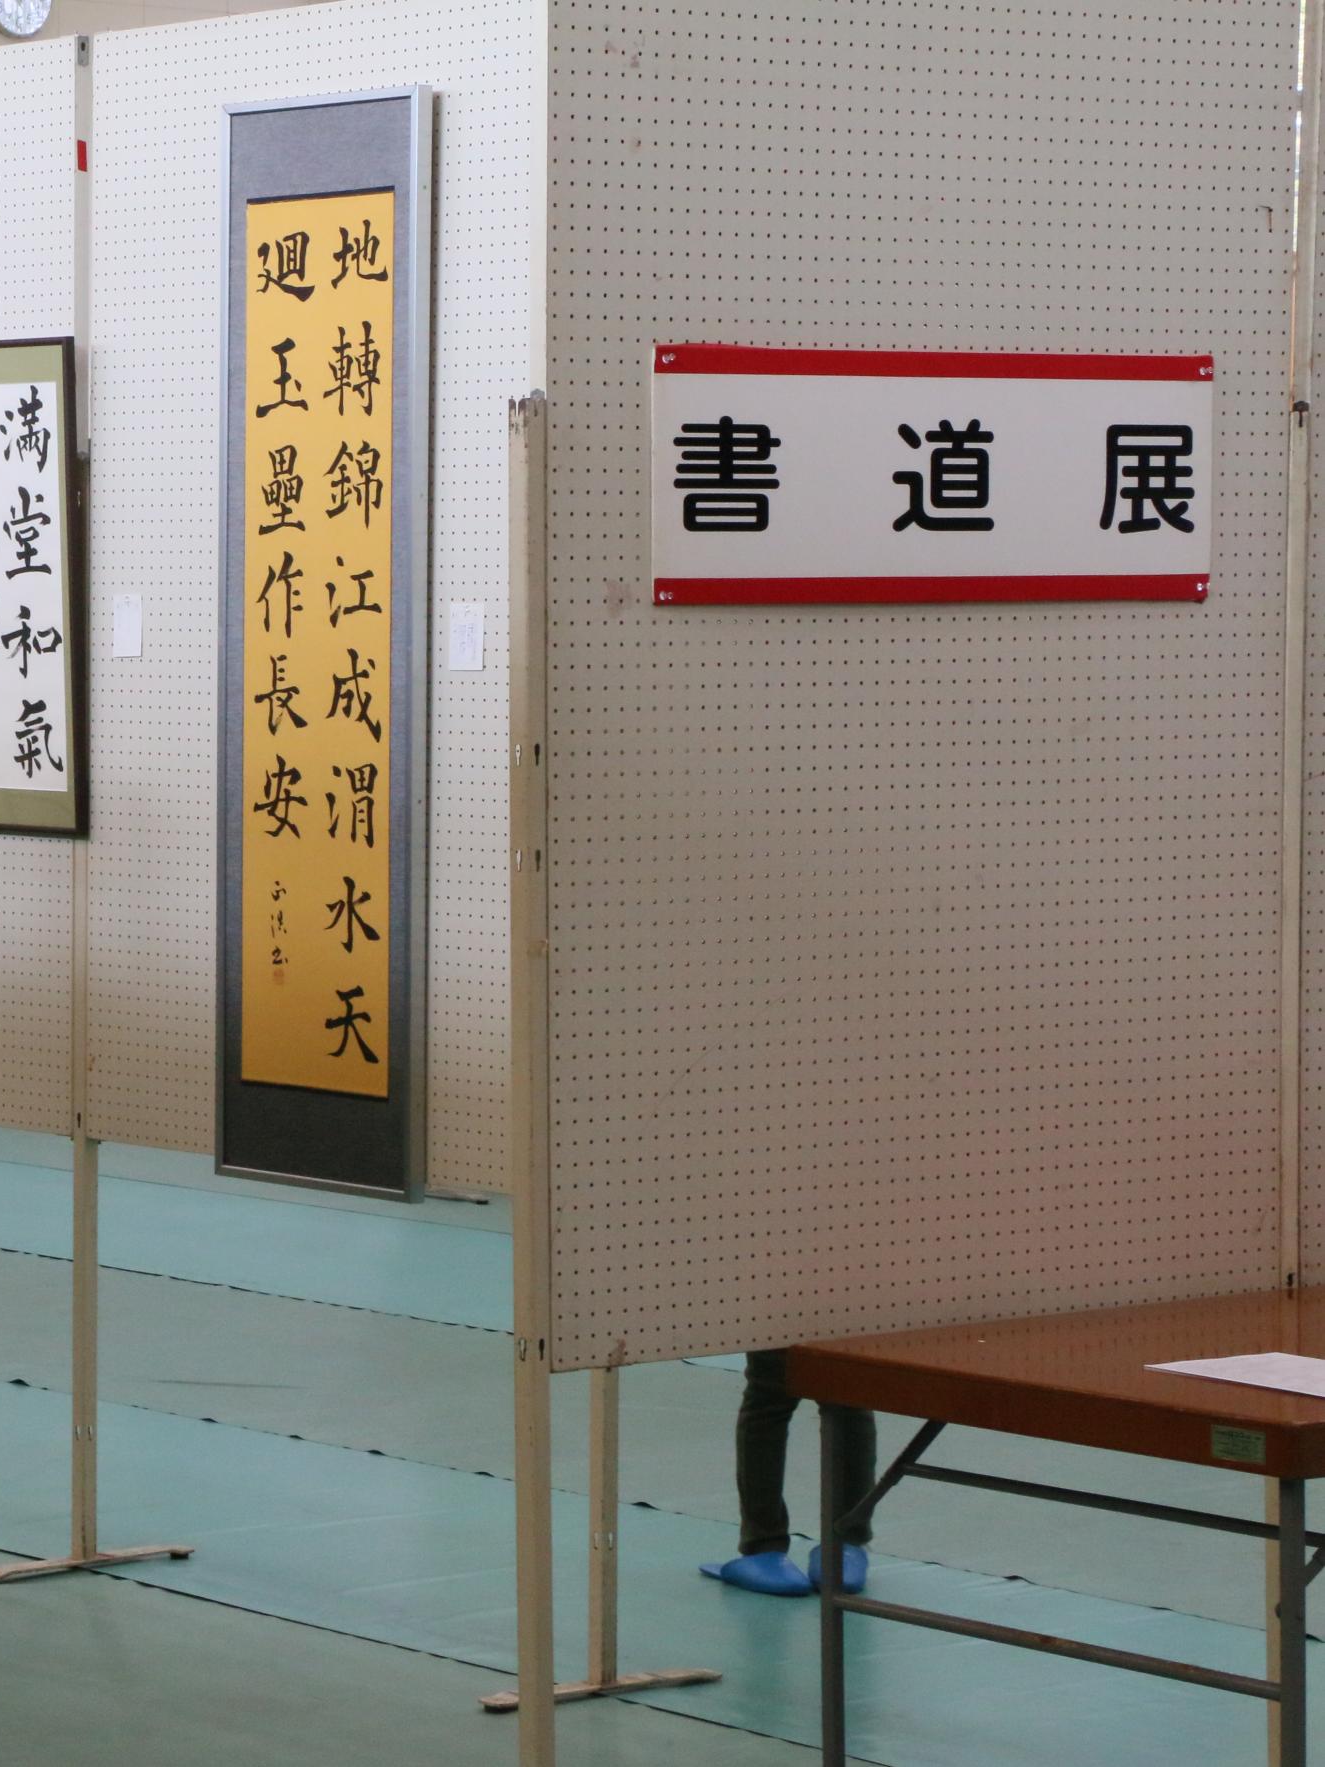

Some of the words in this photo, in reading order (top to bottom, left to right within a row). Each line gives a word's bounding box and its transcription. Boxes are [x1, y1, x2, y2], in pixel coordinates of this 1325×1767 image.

[323, 219, 388, 1063] 地轉錦江成渭水天
[672, 415, 1195, 533] 書道展
